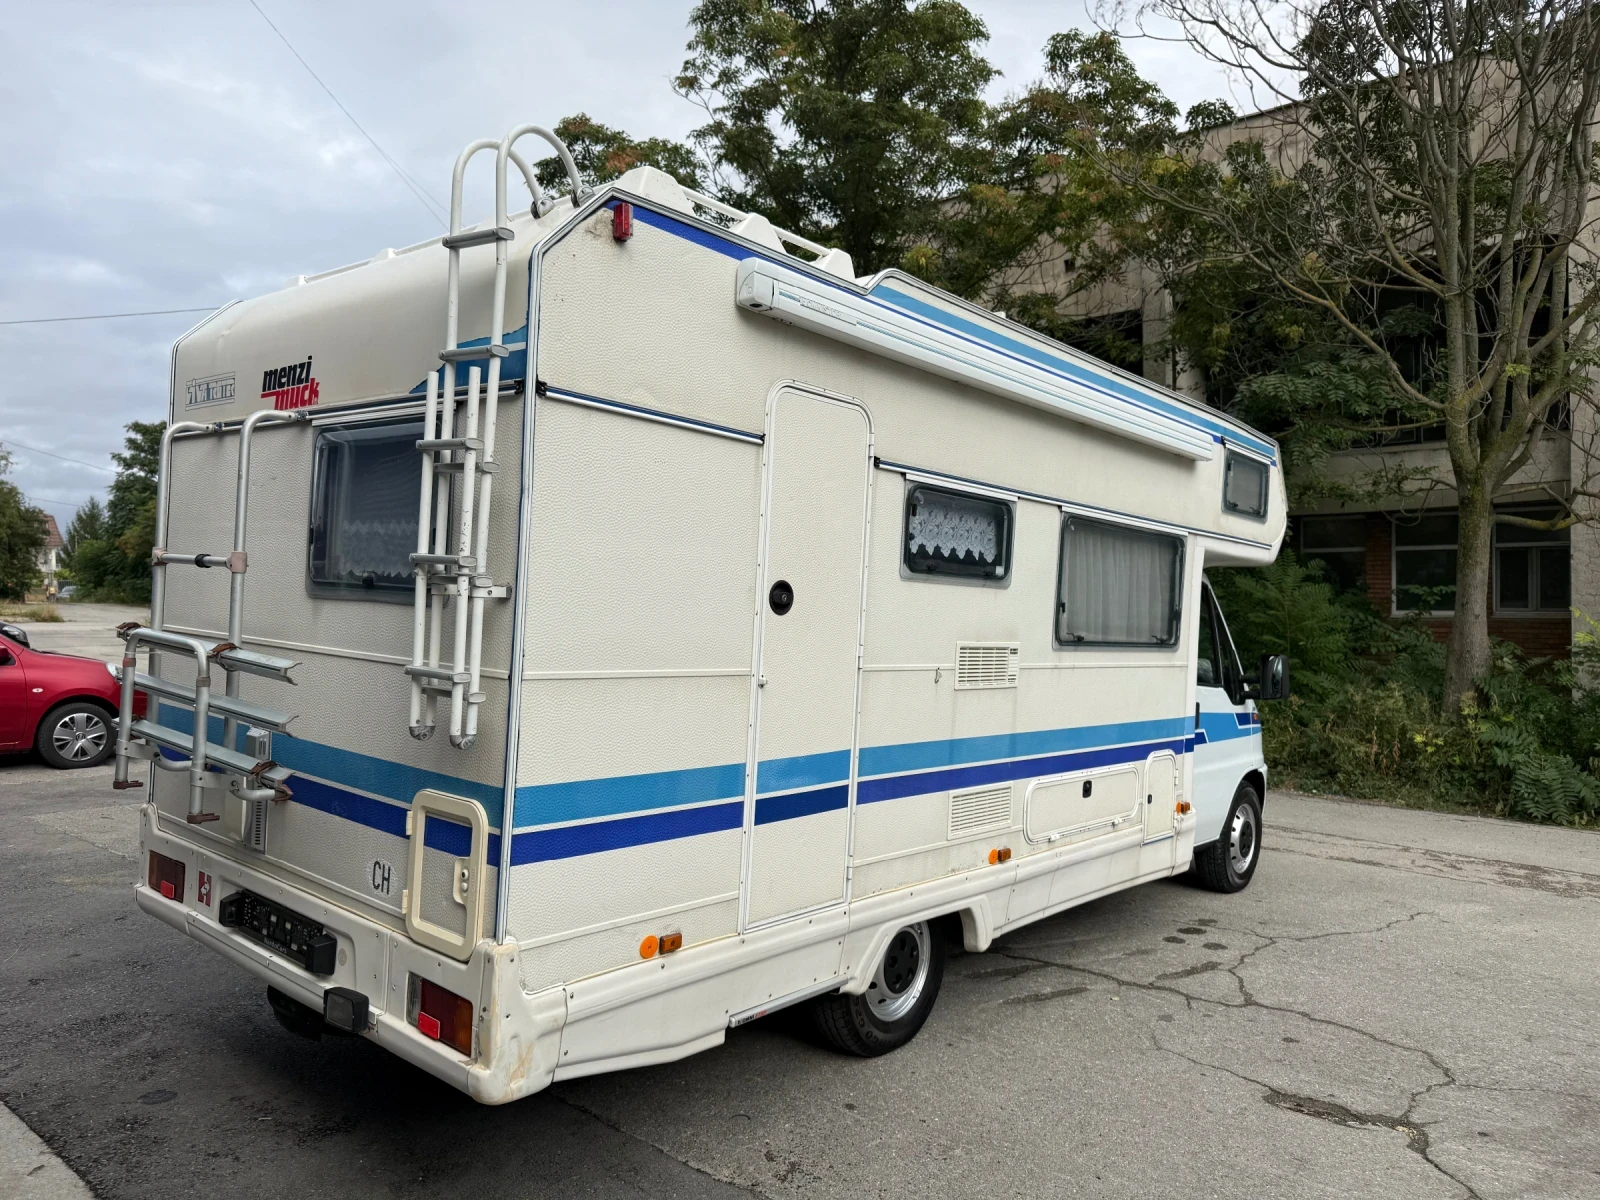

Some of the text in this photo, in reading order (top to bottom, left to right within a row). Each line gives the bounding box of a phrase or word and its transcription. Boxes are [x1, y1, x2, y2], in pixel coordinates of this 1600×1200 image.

[262, 355, 313, 392] menzi
[260, 377, 321, 411] muck
[372, 860, 391, 895] CH
